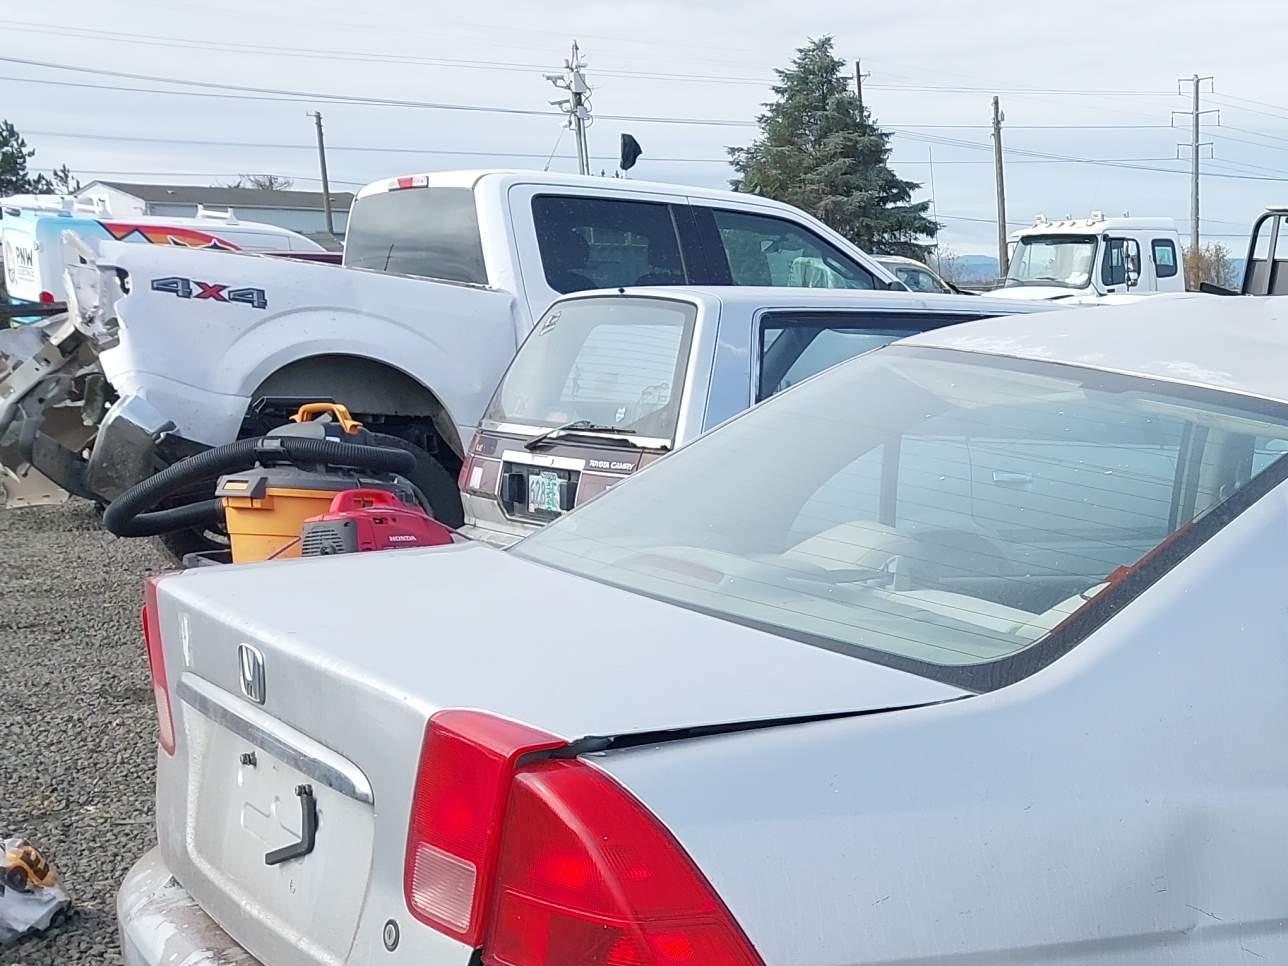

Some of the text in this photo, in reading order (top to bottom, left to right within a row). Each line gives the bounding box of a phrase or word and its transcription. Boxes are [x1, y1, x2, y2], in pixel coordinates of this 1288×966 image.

[16, 246, 33, 266] PNW
[589, 459, 610, 469] TOYOTA
[610, 461, 635, 471] CAMRY
